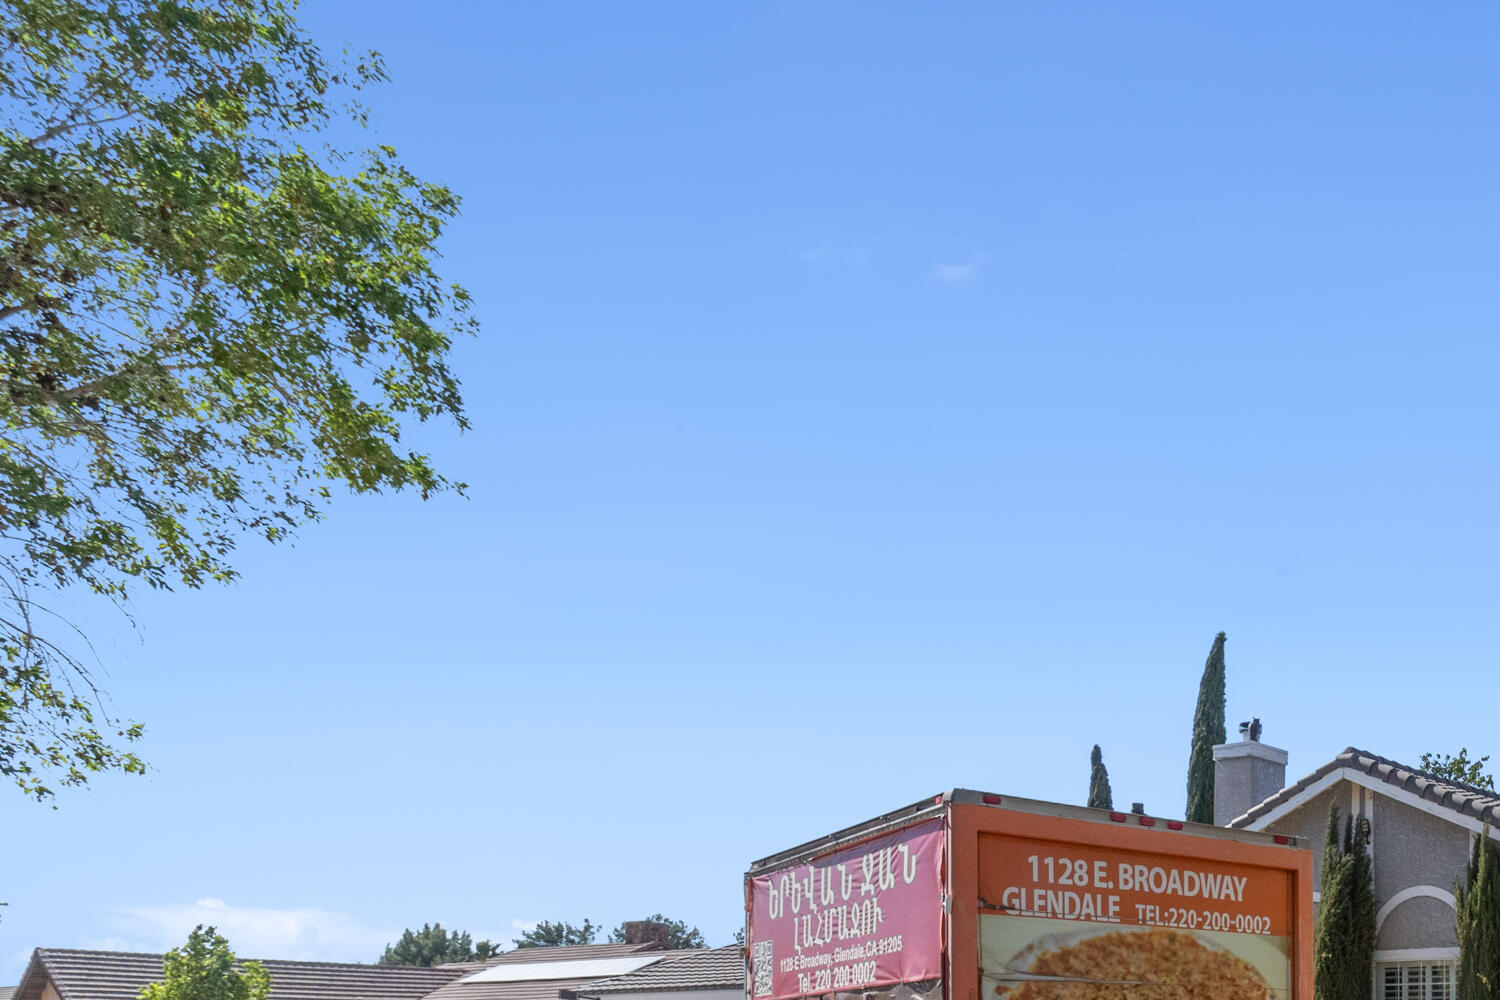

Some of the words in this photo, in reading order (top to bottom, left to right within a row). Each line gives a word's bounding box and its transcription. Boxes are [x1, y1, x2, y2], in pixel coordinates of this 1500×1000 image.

[1028, 855, 1089, 887] 1128
[1093, 860, 1113, 889] E.
[1118, 863, 1248, 901] BROADWAY
[1002, 886, 1120, 923] GLENDALE
[780, 957, 793, 973] 1128
[800, 951, 833, 969] Broadway,
[879, 935, 903, 955] 91205
[815, 968, 832, 991] 220
[833, 964, 850, 987] 200
[852, 960, 877, 984] 0002
